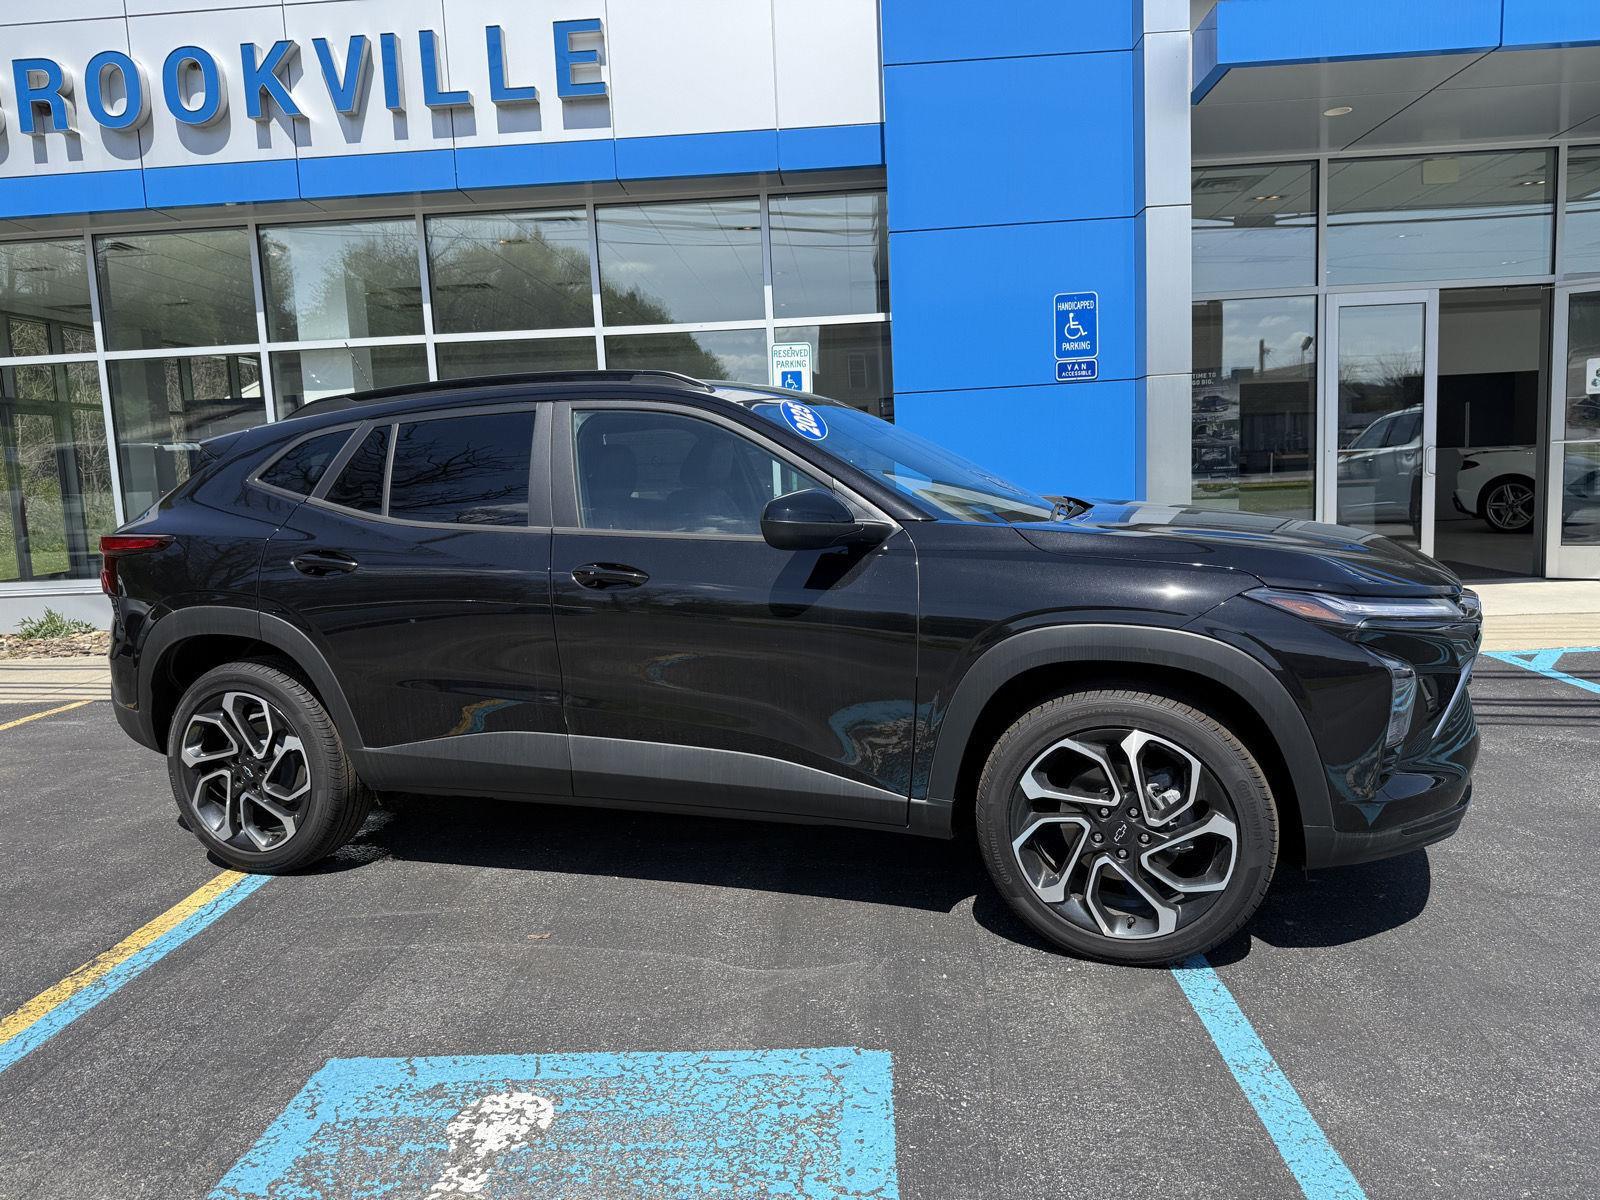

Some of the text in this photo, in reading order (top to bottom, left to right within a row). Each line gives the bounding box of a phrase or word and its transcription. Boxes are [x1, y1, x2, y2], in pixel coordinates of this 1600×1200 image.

[0, 18, 607, 136] ROOKVILLE
[1058, 301, 1094, 311] HANDICAPPED
[1062, 341, 1091, 351] PARKING
[773, 349, 808, 358] RESERVED
[776, 360, 807, 368] PARKING
[786, 402, 822, 437] 2025
